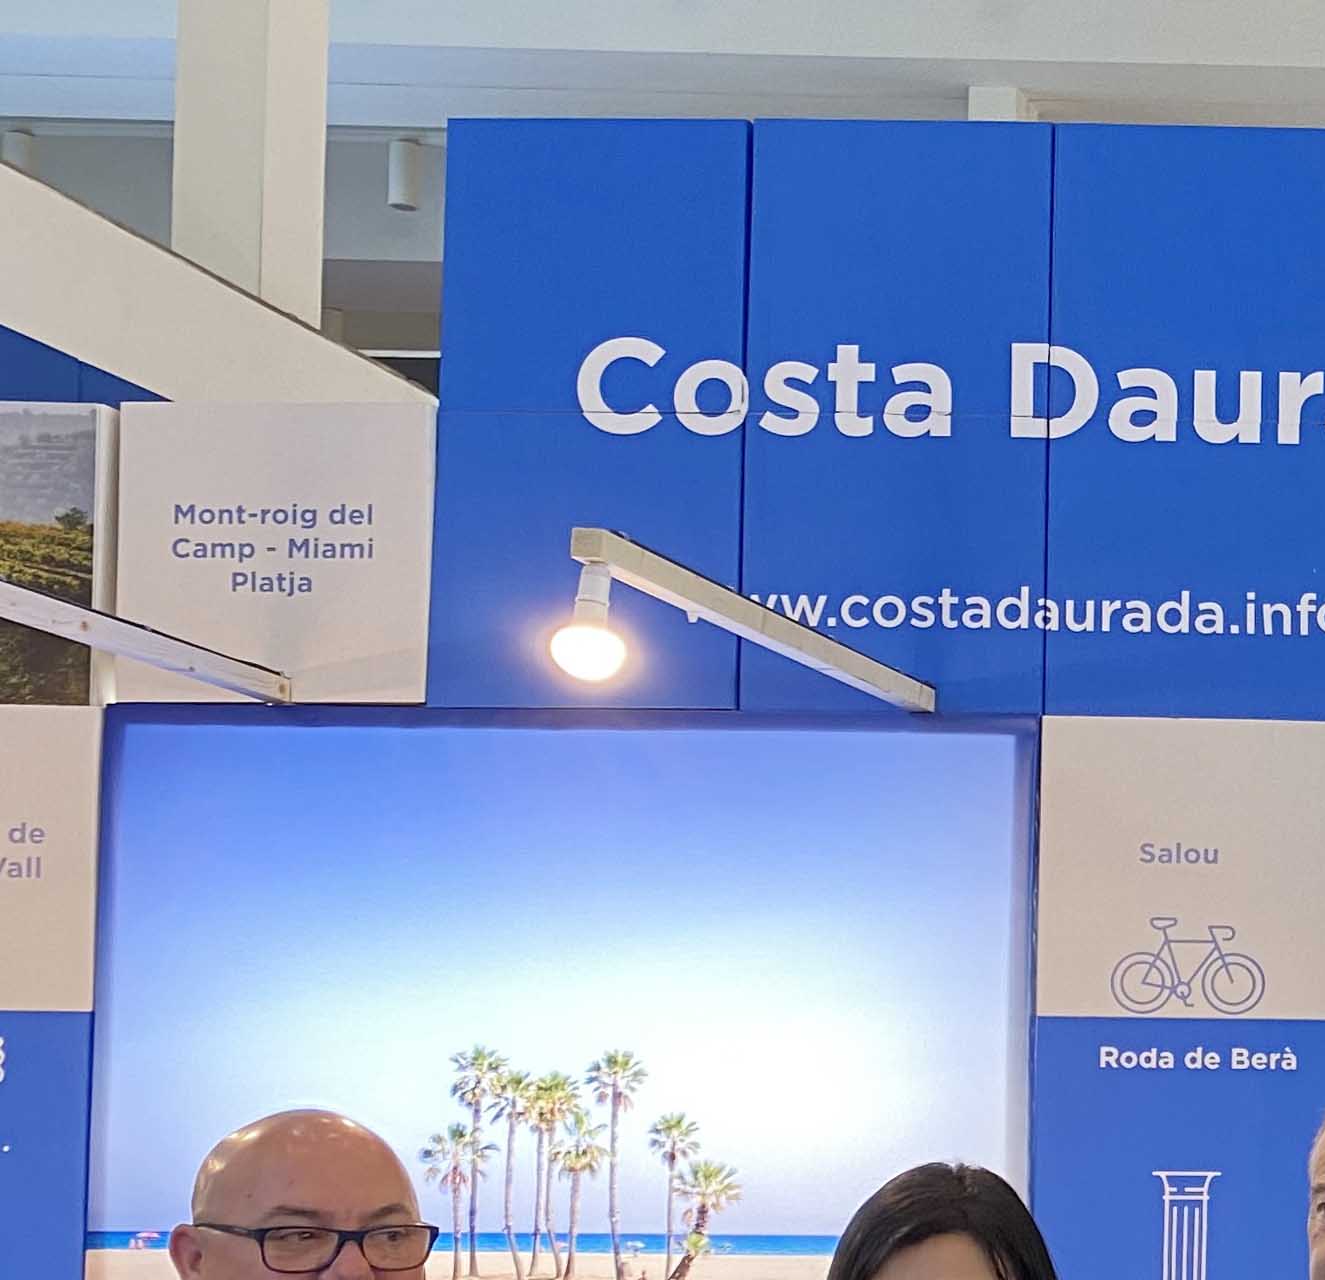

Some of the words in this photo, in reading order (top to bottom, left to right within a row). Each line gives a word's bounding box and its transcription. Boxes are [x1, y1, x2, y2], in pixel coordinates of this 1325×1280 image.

[576, 336, 953, 438] Costa
[174, 503, 318, 530] Mont-roig
[328, 503, 373, 526] del
[171, 537, 256, 564] Camp
[287, 537, 374, 559] Miami
[231, 570, 313, 598] Platja
[7, 821, 46, 845] de
[1139, 842, 1219, 865] Salou
[1099, 1046, 1175, 1069] Roda
[1184, 1046, 1221, 1070] de
[1231, 1046, 1297, 1071] Berà
